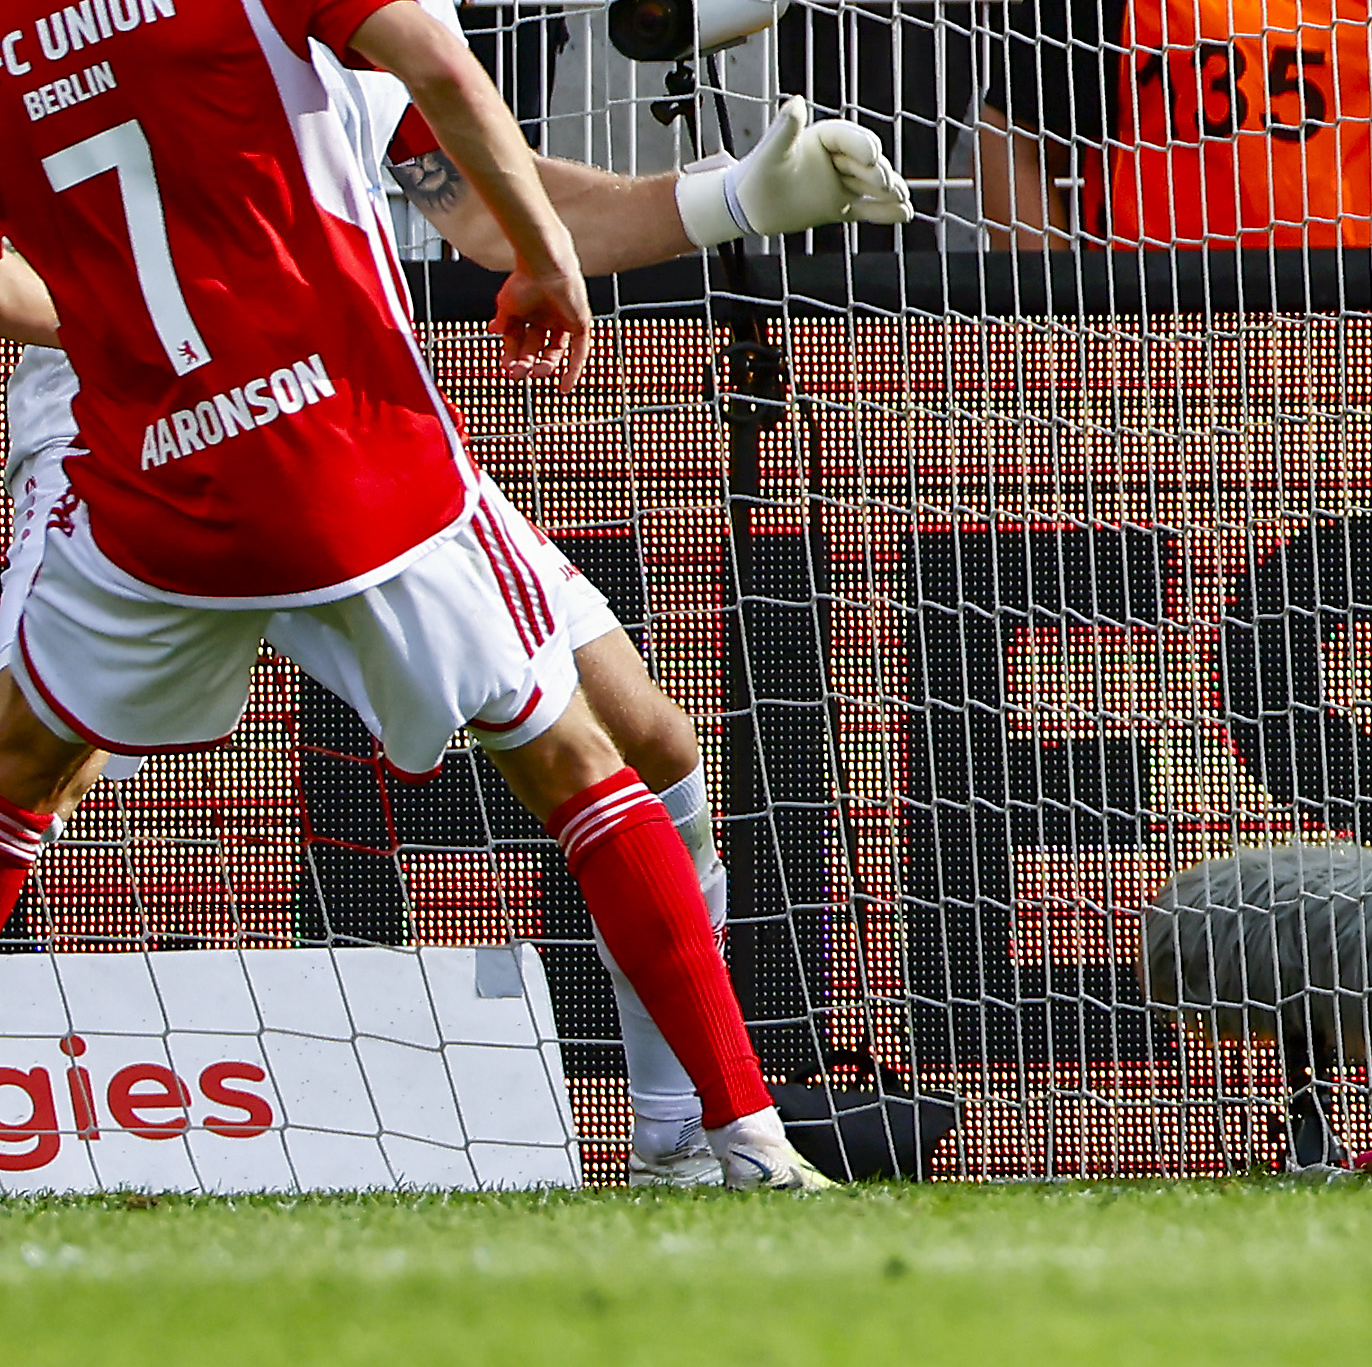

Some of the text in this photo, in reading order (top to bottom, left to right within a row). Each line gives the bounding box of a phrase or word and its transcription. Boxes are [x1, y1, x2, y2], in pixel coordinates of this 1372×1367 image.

[0, 29, 32, 76] C
[22, 61, 117, 122] BERLIN
[41, 118, 213, 377] 7
[140, 353, 336, 472] AARONSON
[0, 1034, 274, 1172] gies
